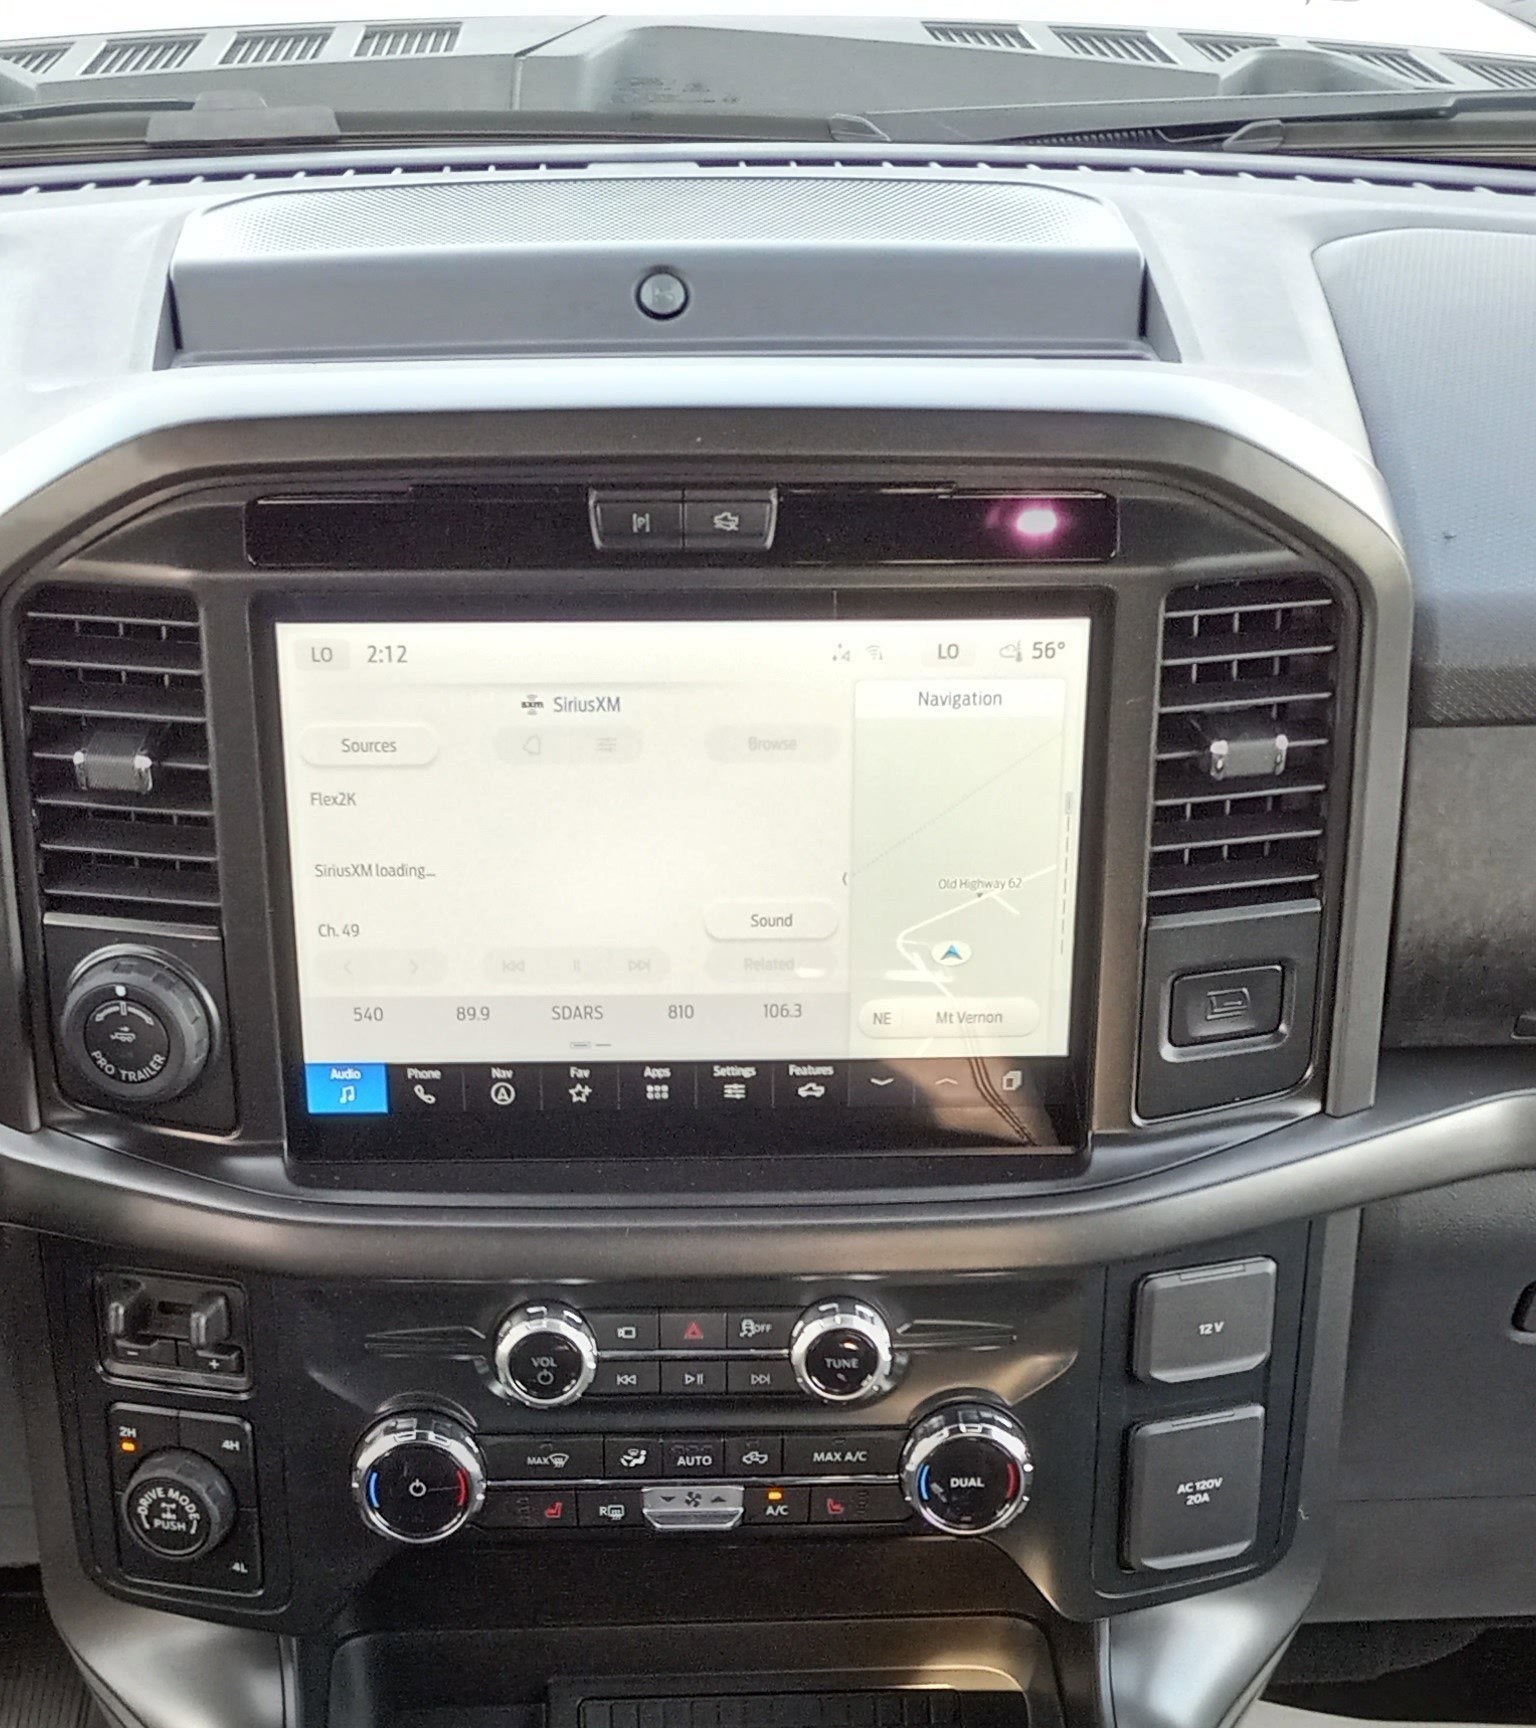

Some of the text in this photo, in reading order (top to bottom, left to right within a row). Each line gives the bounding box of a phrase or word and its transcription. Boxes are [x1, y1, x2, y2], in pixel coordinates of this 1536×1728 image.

[311, 647, 333, 663] LO
[367, 645, 408, 663] 2:12
[938, 643, 959, 660] LO
[553, 696, 621, 714] SiriusXM
[917, 691, 1003, 709] Navigation
[341, 738, 397, 754] Sources
[748, 737, 798, 752] Browse
[310, 792, 357, 807] Flex2K
[314, 864, 372, 878] SiriusXM
[938, 877, 1023, 891] Old Highway 62
[750, 914, 793, 927] Sound
[317, 923, 360, 938] Ch. 49
[744, 958, 794, 972] Related
[353, 1006, 384, 1022] 540
[456, 1006, 491, 1021] 89.9
[551, 1005, 604, 1021] SDARS
[667, 1004, 695, 1020] 810
[763, 1003, 803, 1019] 106.3
[872, 1011, 892, 1025] NE
[936, 1011, 1003, 1024] Mt Vernon
[91, 1050, 166, 1082] PRO TRAILER
[491, 1067, 513, 1079] Nav
[569, 1067, 590, 1079] Fav
[713, 1065, 756, 1079] Settings
[789, 1065, 834, 1077] Features
[330, 1068, 361, 1080] Audio
[407, 1067, 441, 1080] Phone
[644, 1066, 671, 1081] Apps
[755, 1324, 772, 1333] OFF
[531, 1357, 557, 1368] VOL
[824, 1358, 858, 1369] TUNE
[119, 1426, 137, 1438] 2H
[221, 1440, 240, 1451] 4H
[527, 1456, 548, 1466] MAX
[677, 1456, 712, 1466] AUTO
[814, 1452, 867, 1462] MAX A/C
[950, 1477, 985, 1488] DUAL
[1177, 1477, 1223, 1494] AC 120V
[137, 1487, 200, 1520] DRIVE MODE
[1186, 1492, 1210, 1505] 20A
[766, 1506, 788, 1517] A/C
[153, 1518, 187, 1531] PUSH
[231, 1562, 248, 1574] 4L
